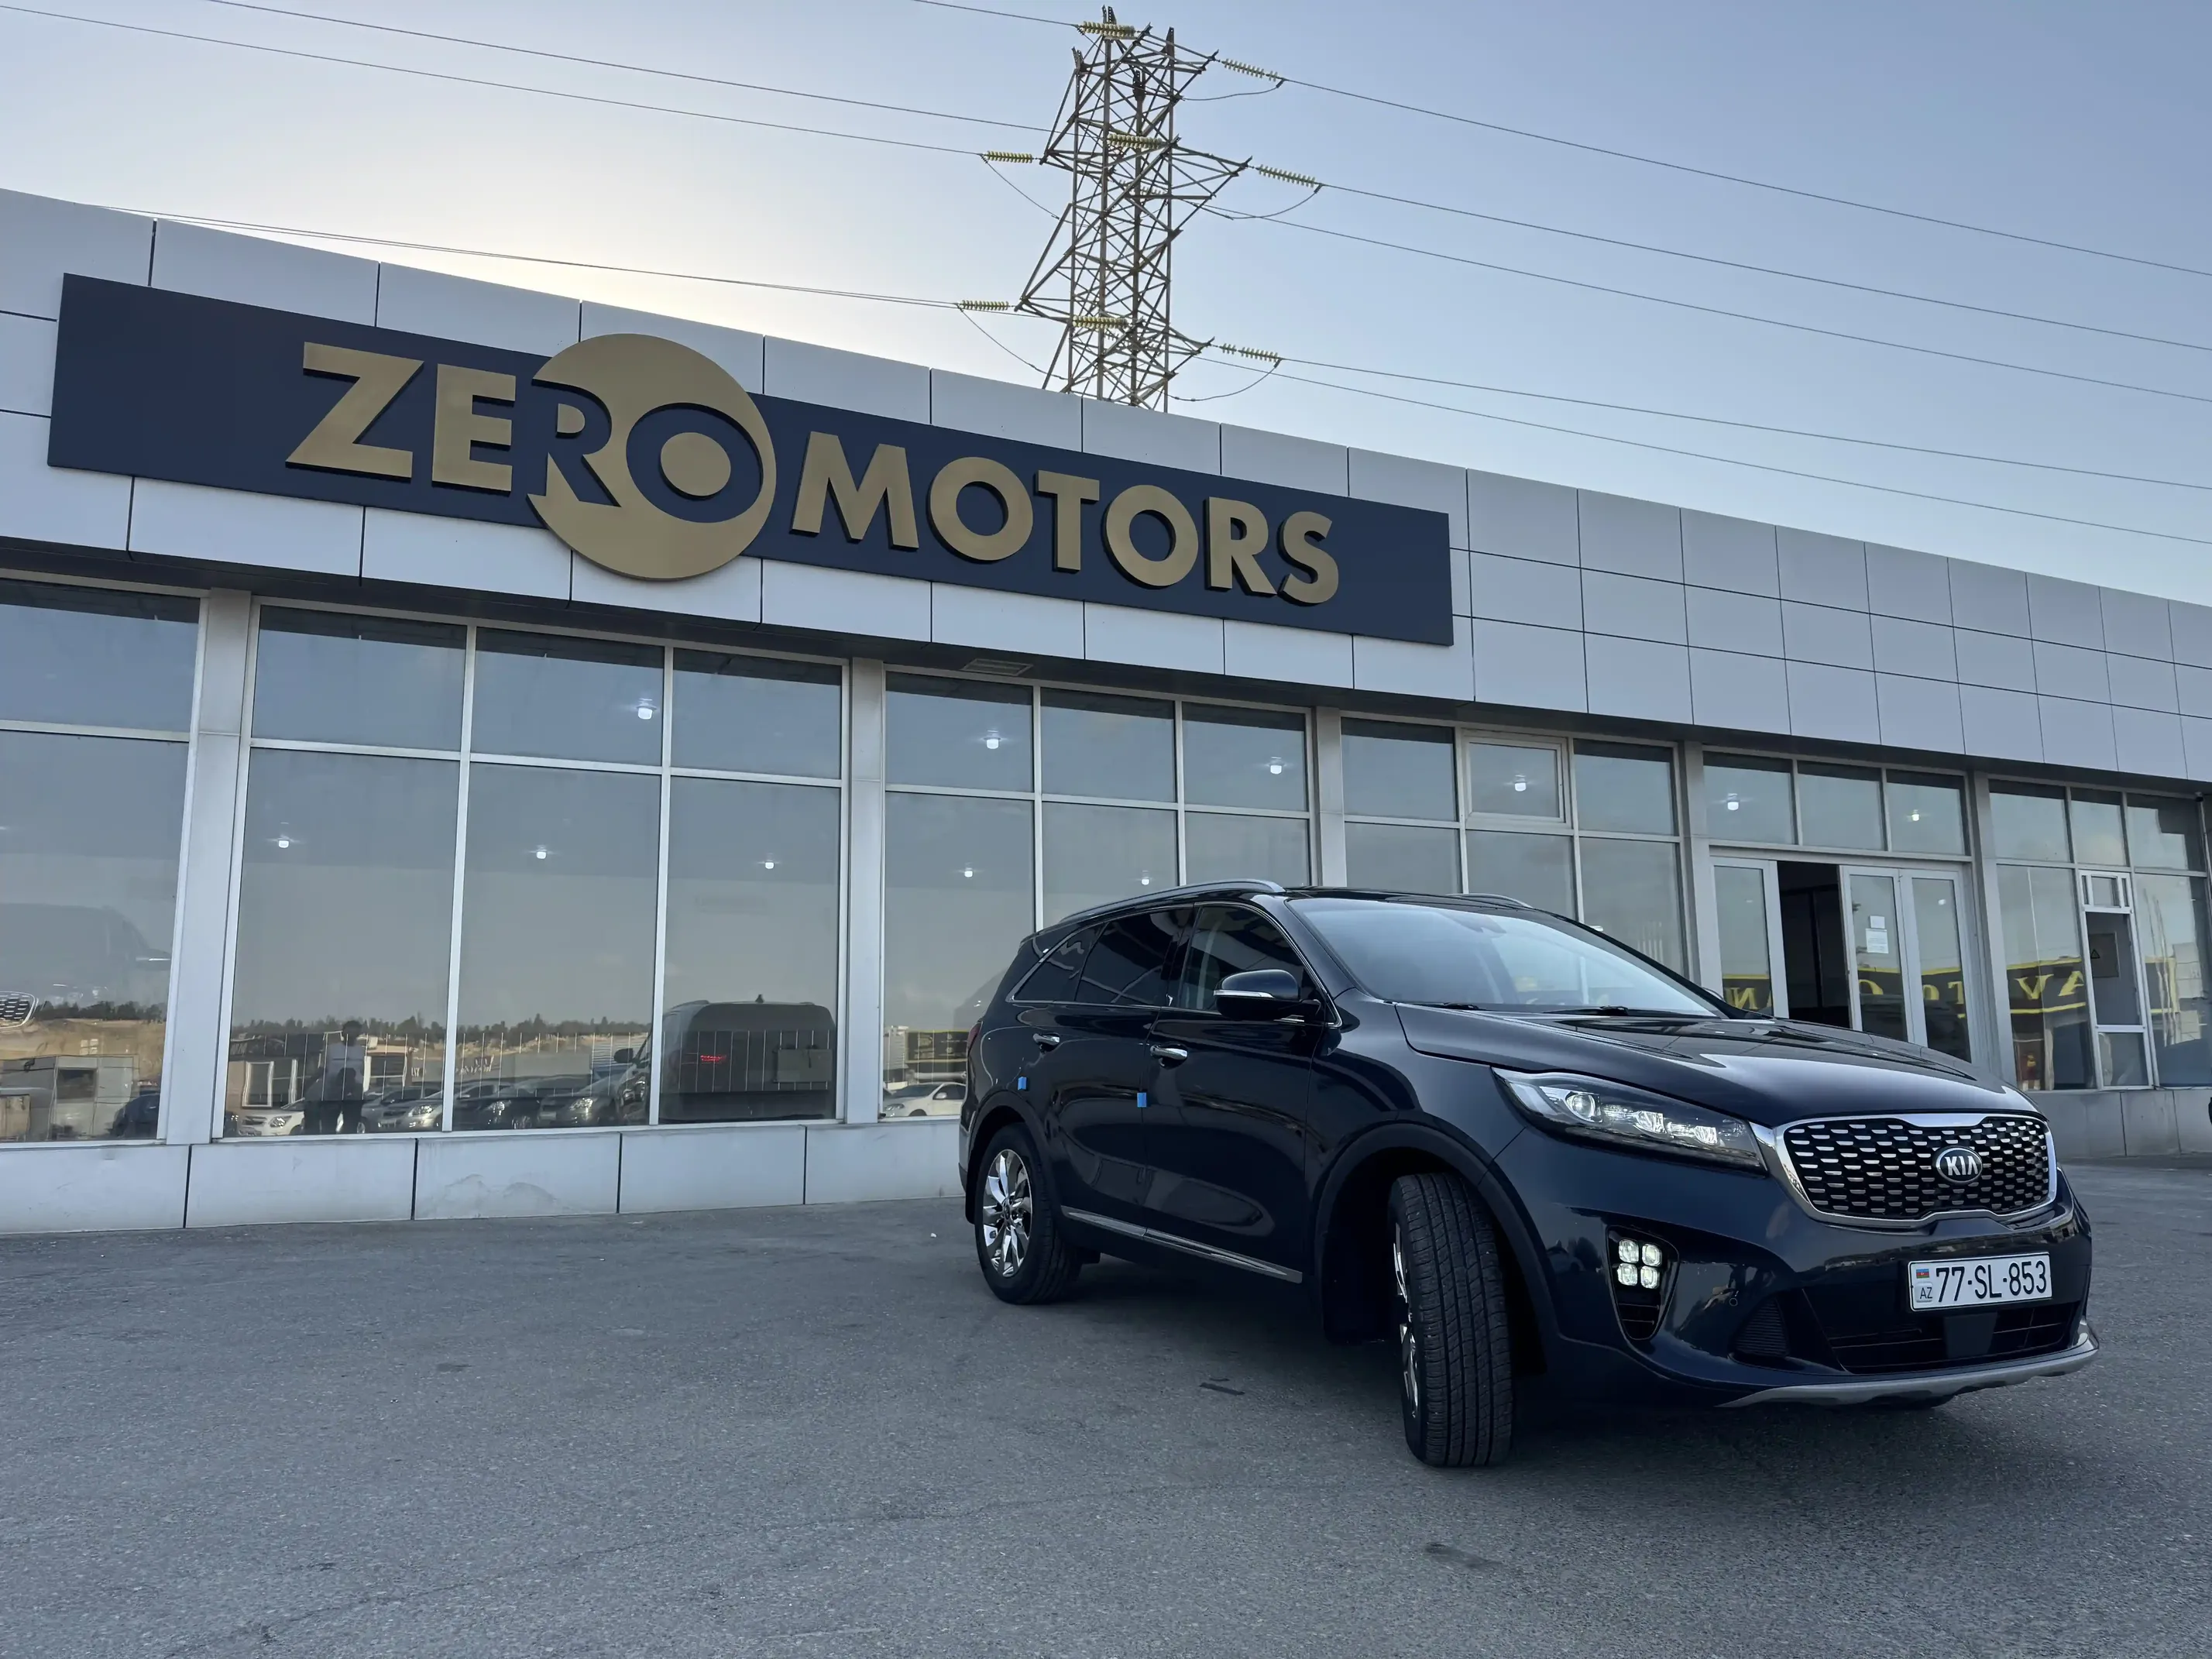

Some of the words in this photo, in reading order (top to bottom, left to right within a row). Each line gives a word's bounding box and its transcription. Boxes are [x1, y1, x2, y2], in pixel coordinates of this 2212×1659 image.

[286, 342, 764, 524] ZERO
[791, 431, 1340, 606] MOTORS
[1944, 1156, 1979, 1176] KIA
[1919, 1286, 1933, 1300] AZ
